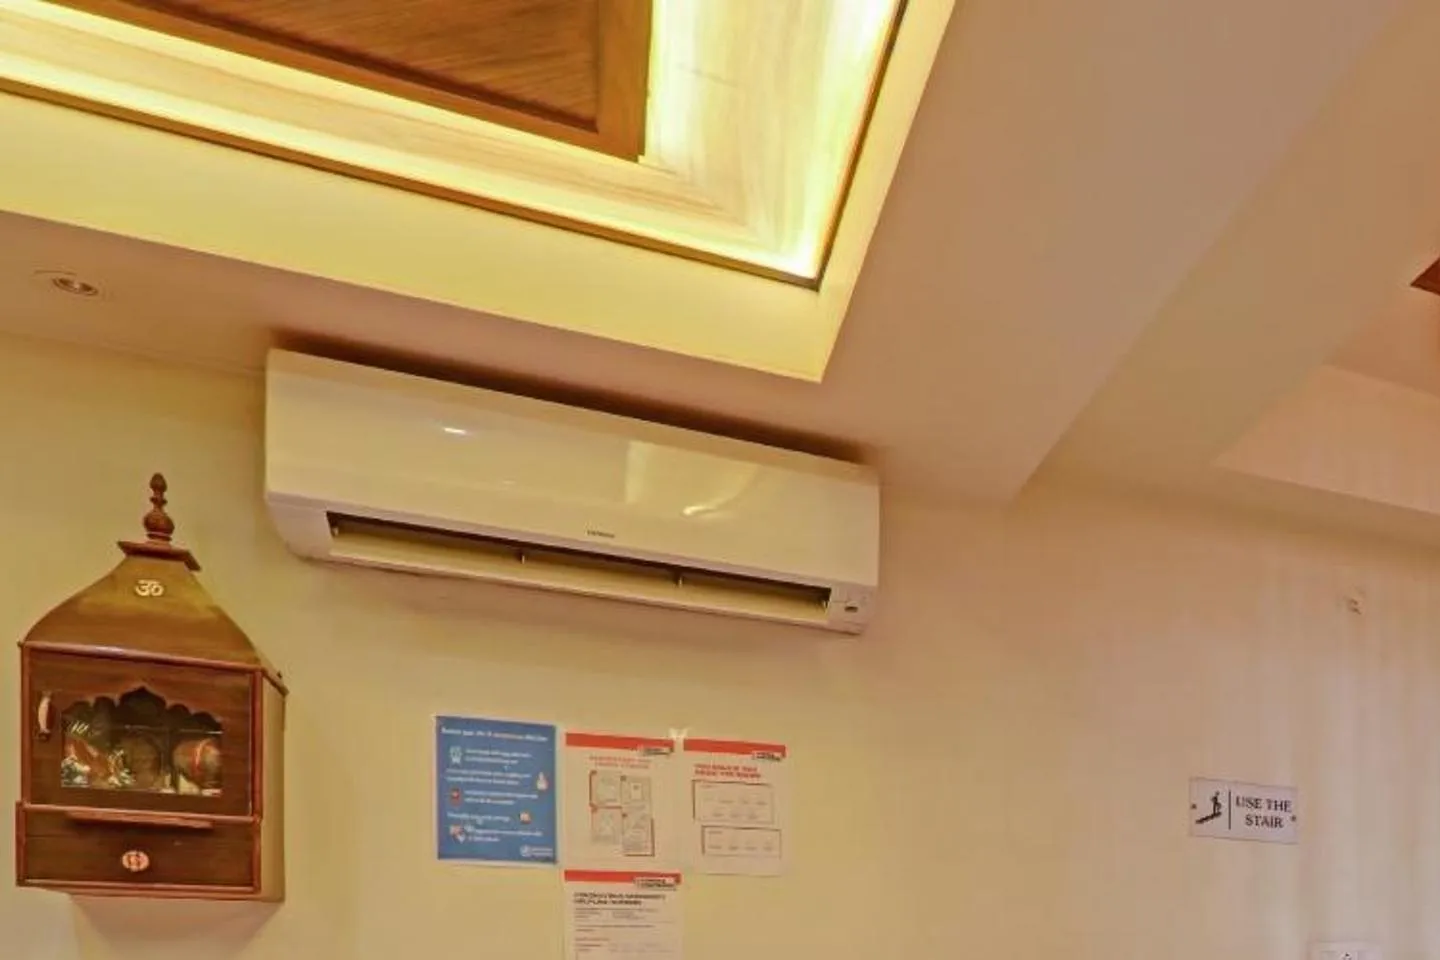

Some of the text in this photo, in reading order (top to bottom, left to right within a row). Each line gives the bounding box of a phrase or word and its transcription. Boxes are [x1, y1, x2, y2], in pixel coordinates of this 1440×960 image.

[1236, 796, 1293, 813] USE THE
[1245, 814, 1284, 828] STAIR
